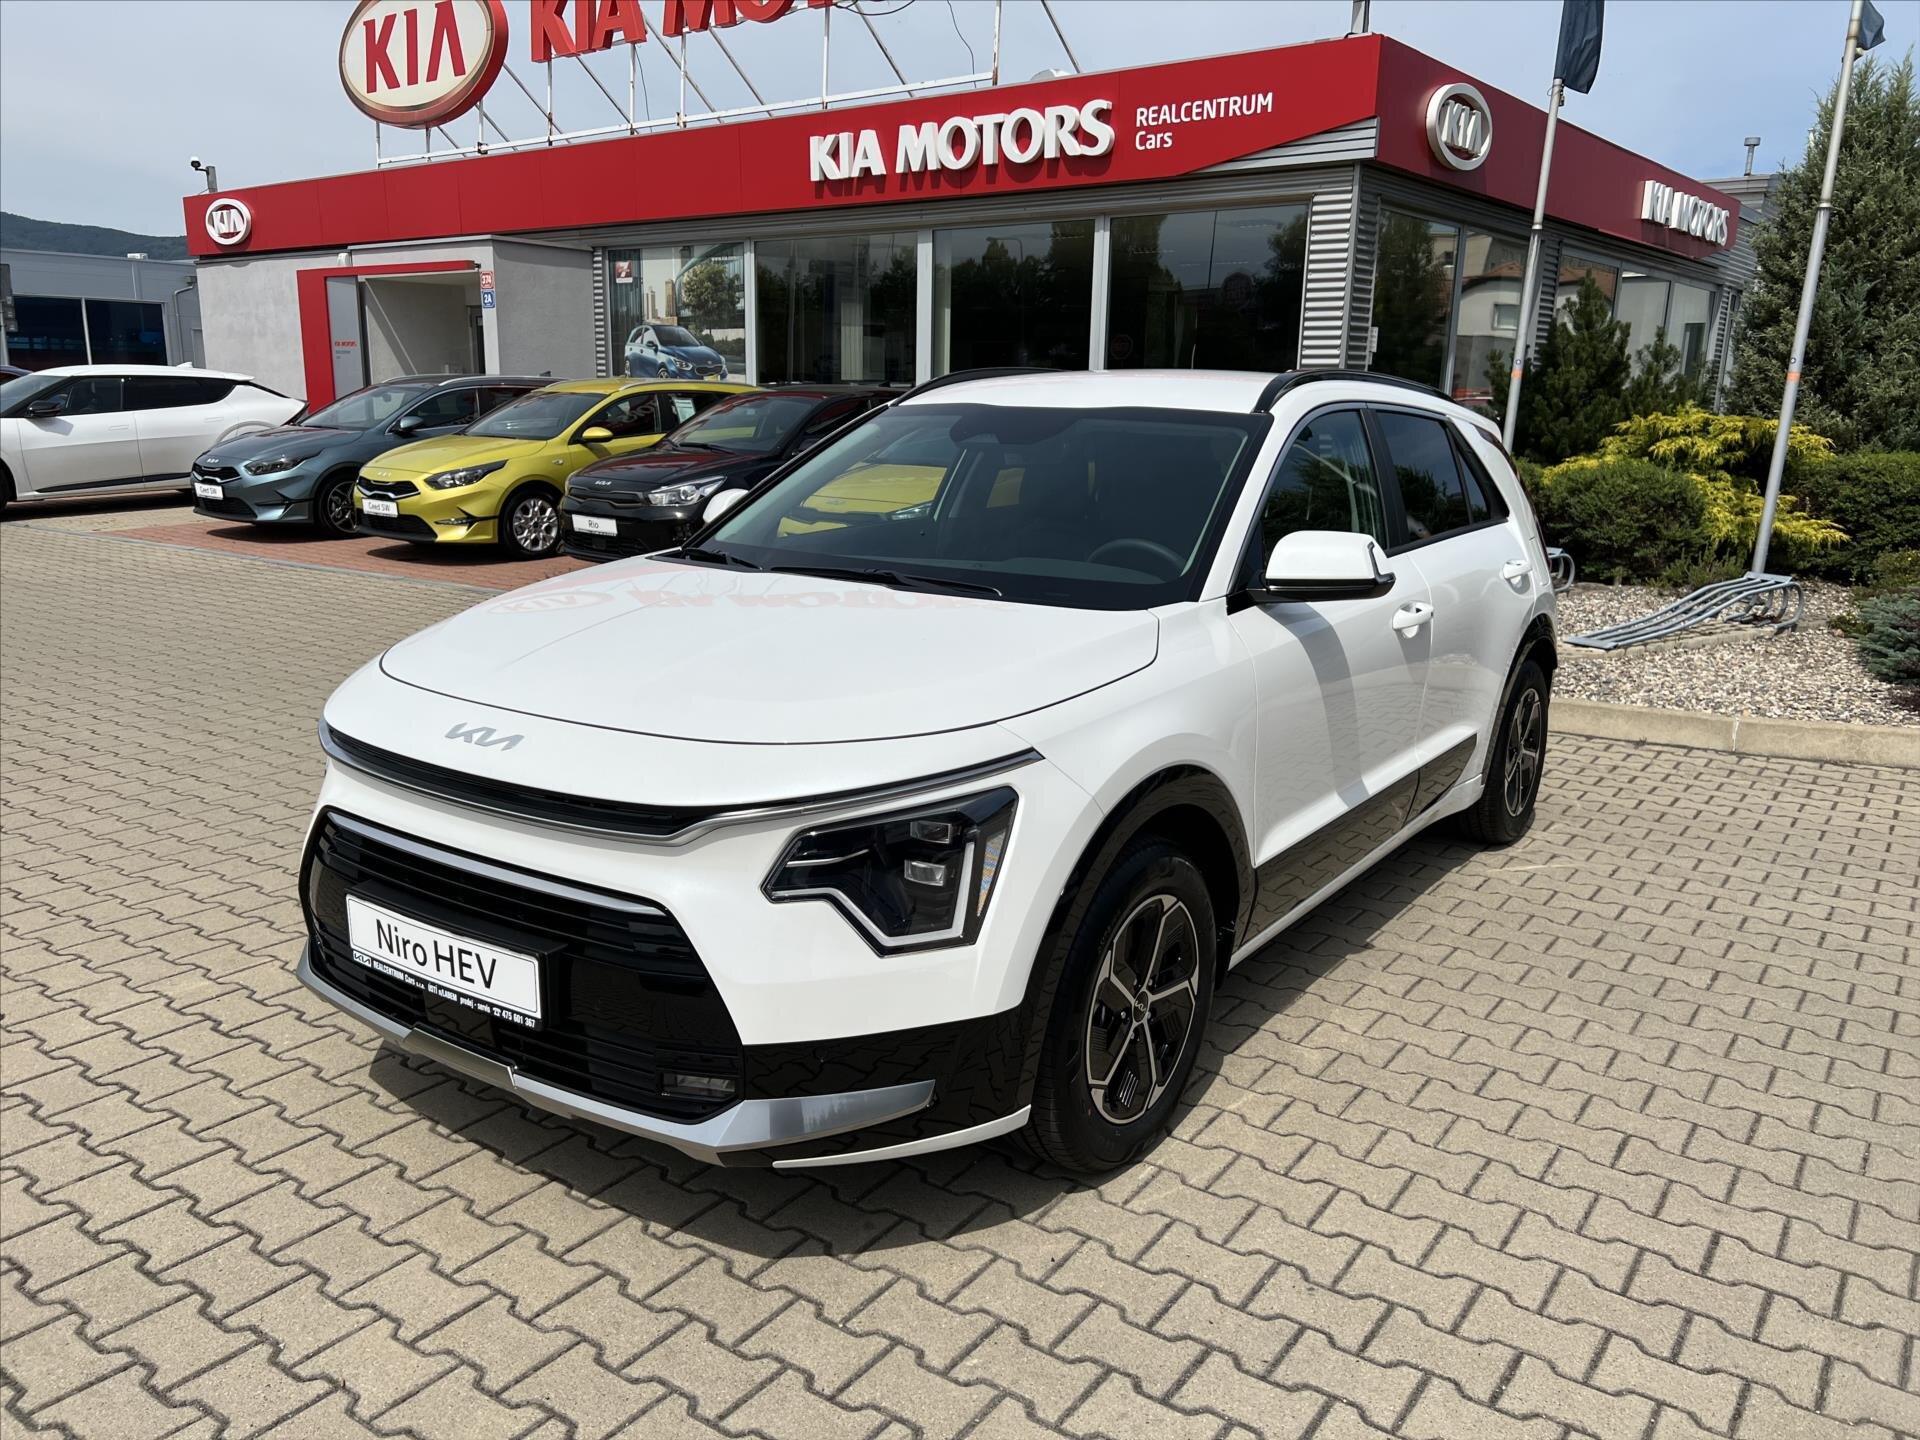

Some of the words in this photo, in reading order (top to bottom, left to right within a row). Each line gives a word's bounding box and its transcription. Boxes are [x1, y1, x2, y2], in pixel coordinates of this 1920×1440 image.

[363, 1, 466, 93] KIA
[1136, 92, 1273, 127] REALCENTRUM
[809, 131, 886, 181] KIA
[896, 99, 1114, 174] MOTORS
[1136, 131, 1173, 151] Cars
[1441, 100, 1481, 156] KIA
[212, 208, 244, 236] KIA
[1641, 180, 1674, 226] KIA
[1669, 192, 1730, 247] MOTORS
[484, 293, 493, 304] 2A
[588, 519, 599, 529] Rio
[376, 918, 428, 967] Niro
[433, 939, 497, 990] HEV
[502, 1010, 513, 1021] 475
